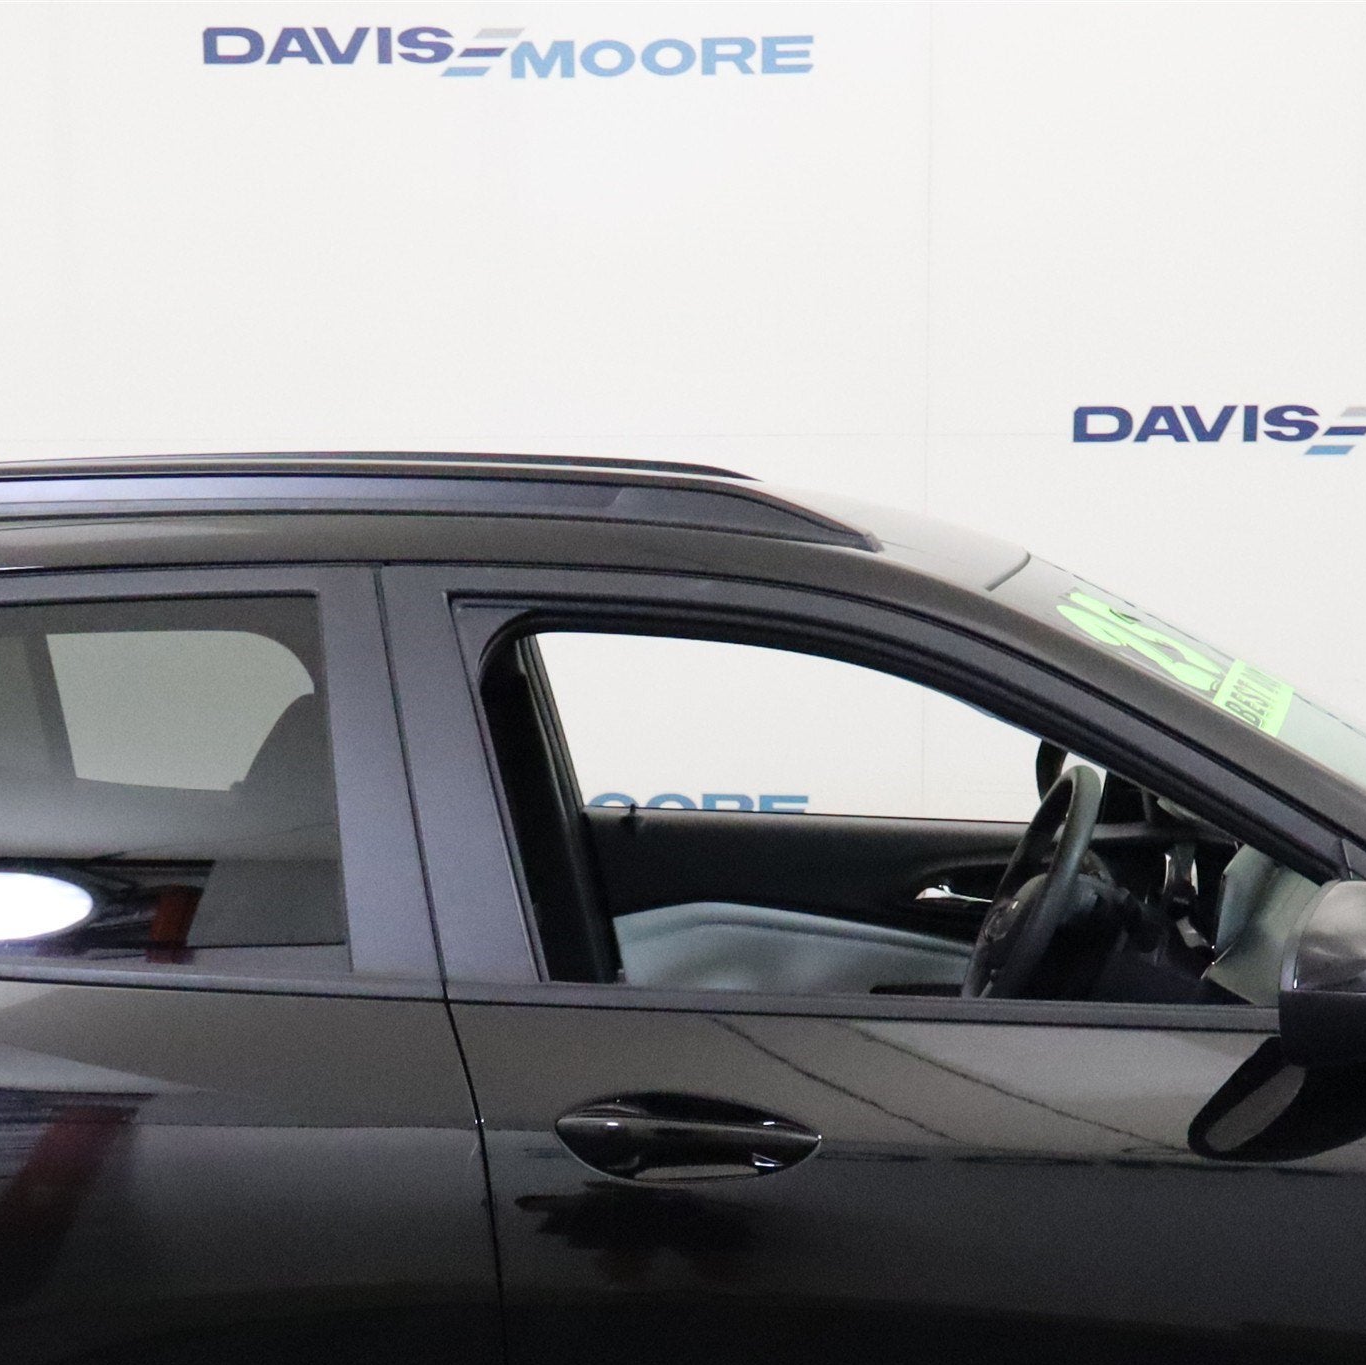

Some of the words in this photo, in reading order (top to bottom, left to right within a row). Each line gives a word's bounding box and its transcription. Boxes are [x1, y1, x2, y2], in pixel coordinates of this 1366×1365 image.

[202, 26, 455, 65] DAVIS
[510, 35, 815, 79] MOORE
[1072, 404, 1321, 443] DAVIS
